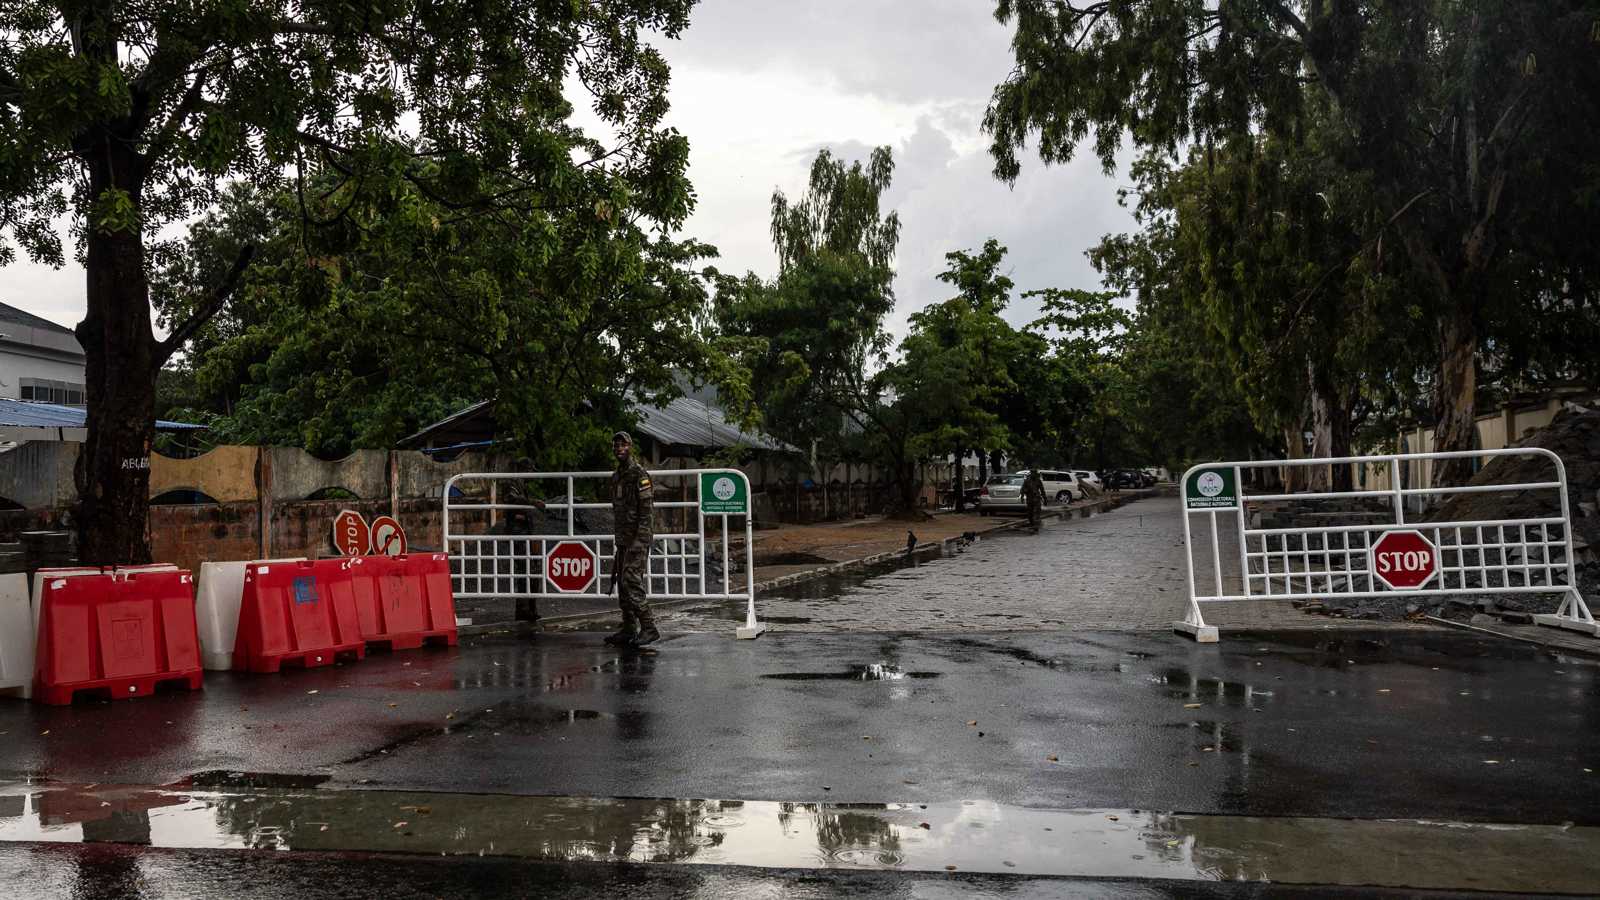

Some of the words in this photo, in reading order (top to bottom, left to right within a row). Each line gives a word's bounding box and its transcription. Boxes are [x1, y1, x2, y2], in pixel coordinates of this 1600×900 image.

[346, 516, 360, 555] STOP
[551, 557, 591, 577] STOP
[1378, 550, 1430, 573] STOP
